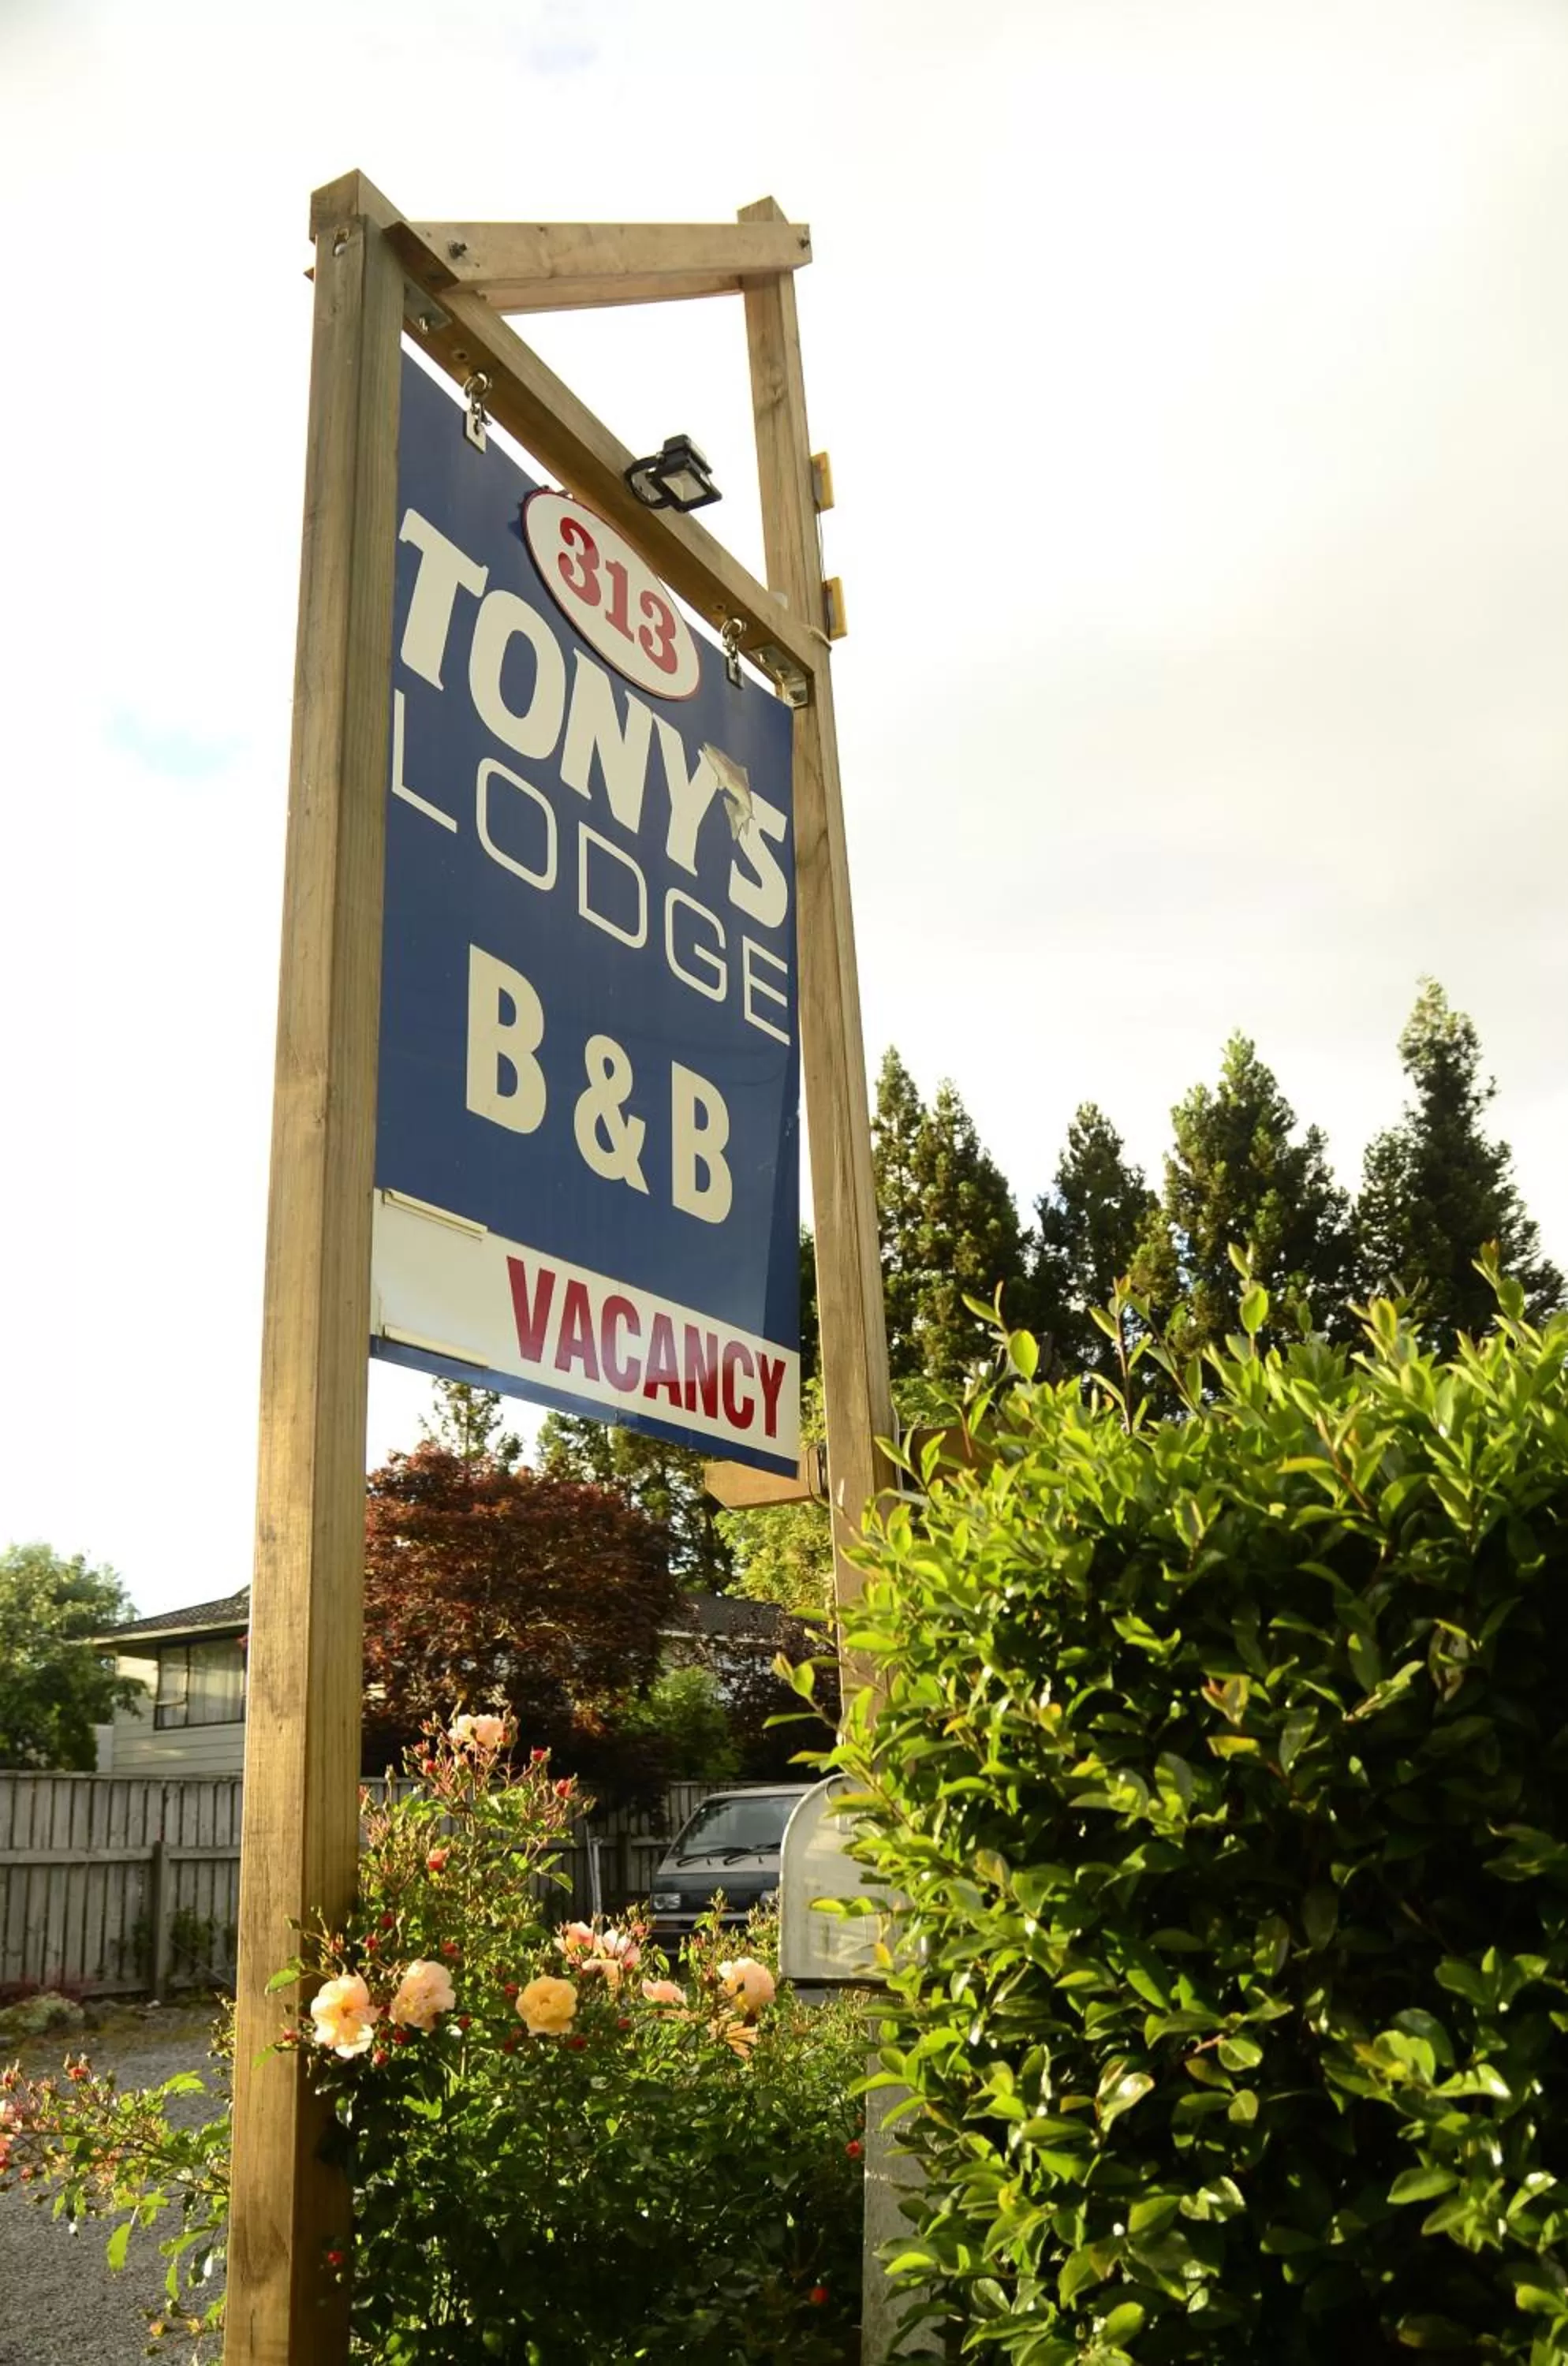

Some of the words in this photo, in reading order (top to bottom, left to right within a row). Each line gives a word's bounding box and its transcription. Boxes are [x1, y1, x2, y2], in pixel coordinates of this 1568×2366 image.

[557, 516, 678, 675] 313
[391, 689, 791, 1047] LODGE
[465, 944, 547, 1134] B
[573, 1034, 650, 1195] &
[671, 1061, 734, 1224] B
[506, 1255, 787, 1439] VACANCY
